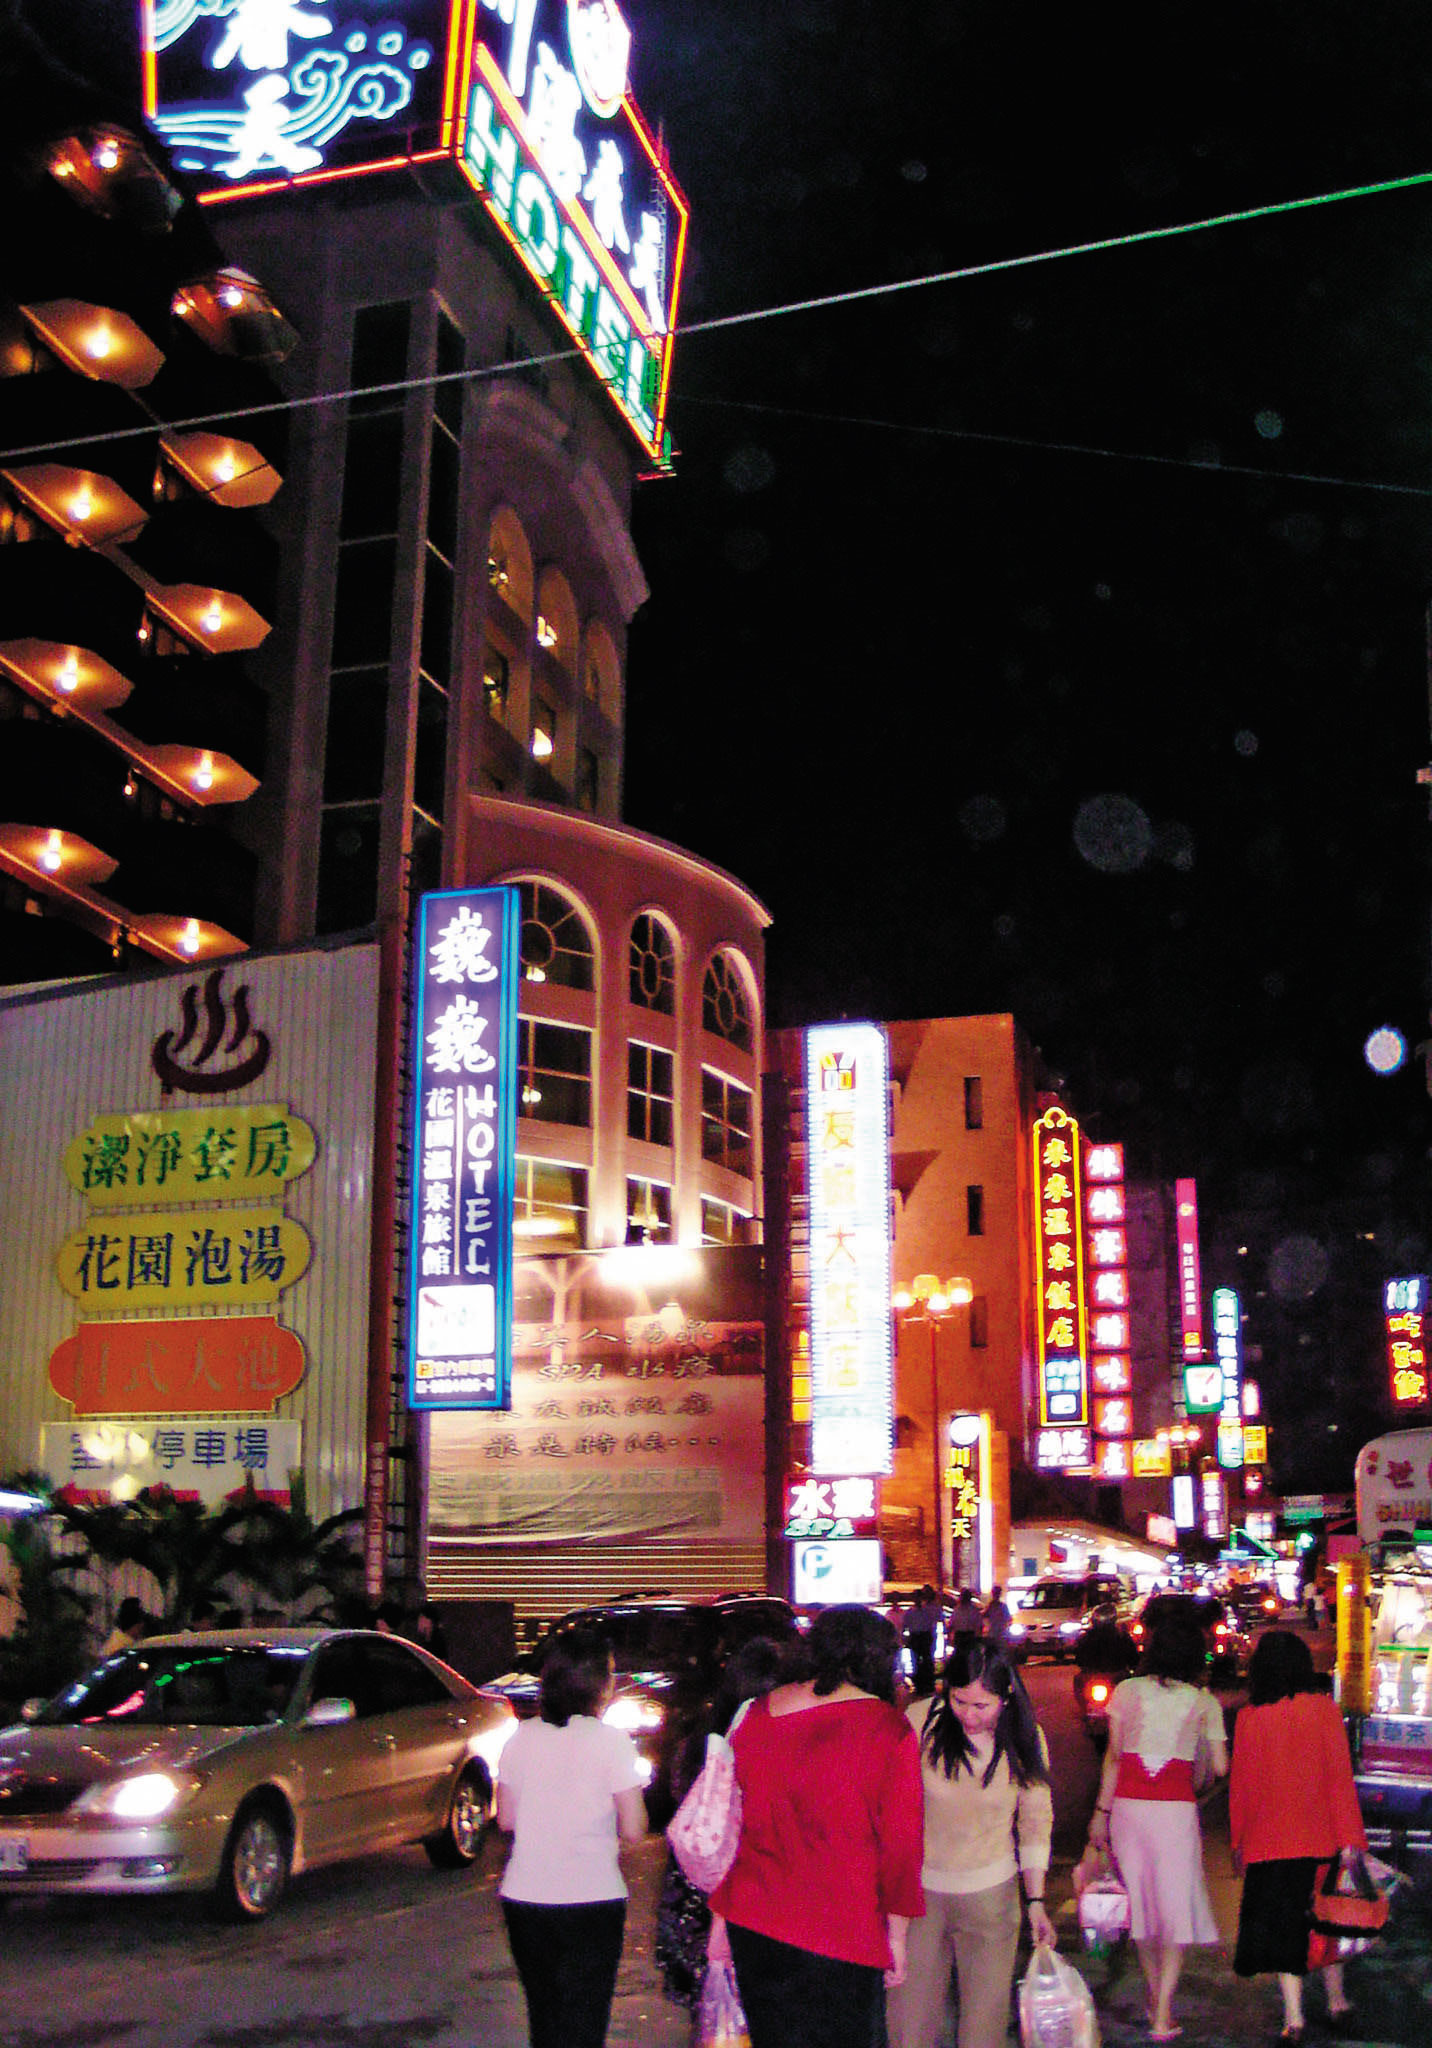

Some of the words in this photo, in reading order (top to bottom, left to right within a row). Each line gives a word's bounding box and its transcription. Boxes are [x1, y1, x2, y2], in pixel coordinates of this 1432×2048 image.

[465, 83, 656, 442] HOTEL
[83, 1120, 292, 1189] 潔淨套房
[464, 1083, 498, 1276] HOTEL
[75, 1225, 287, 1292] 花園泡湯
[784, 1518, 856, 1540] SPA
